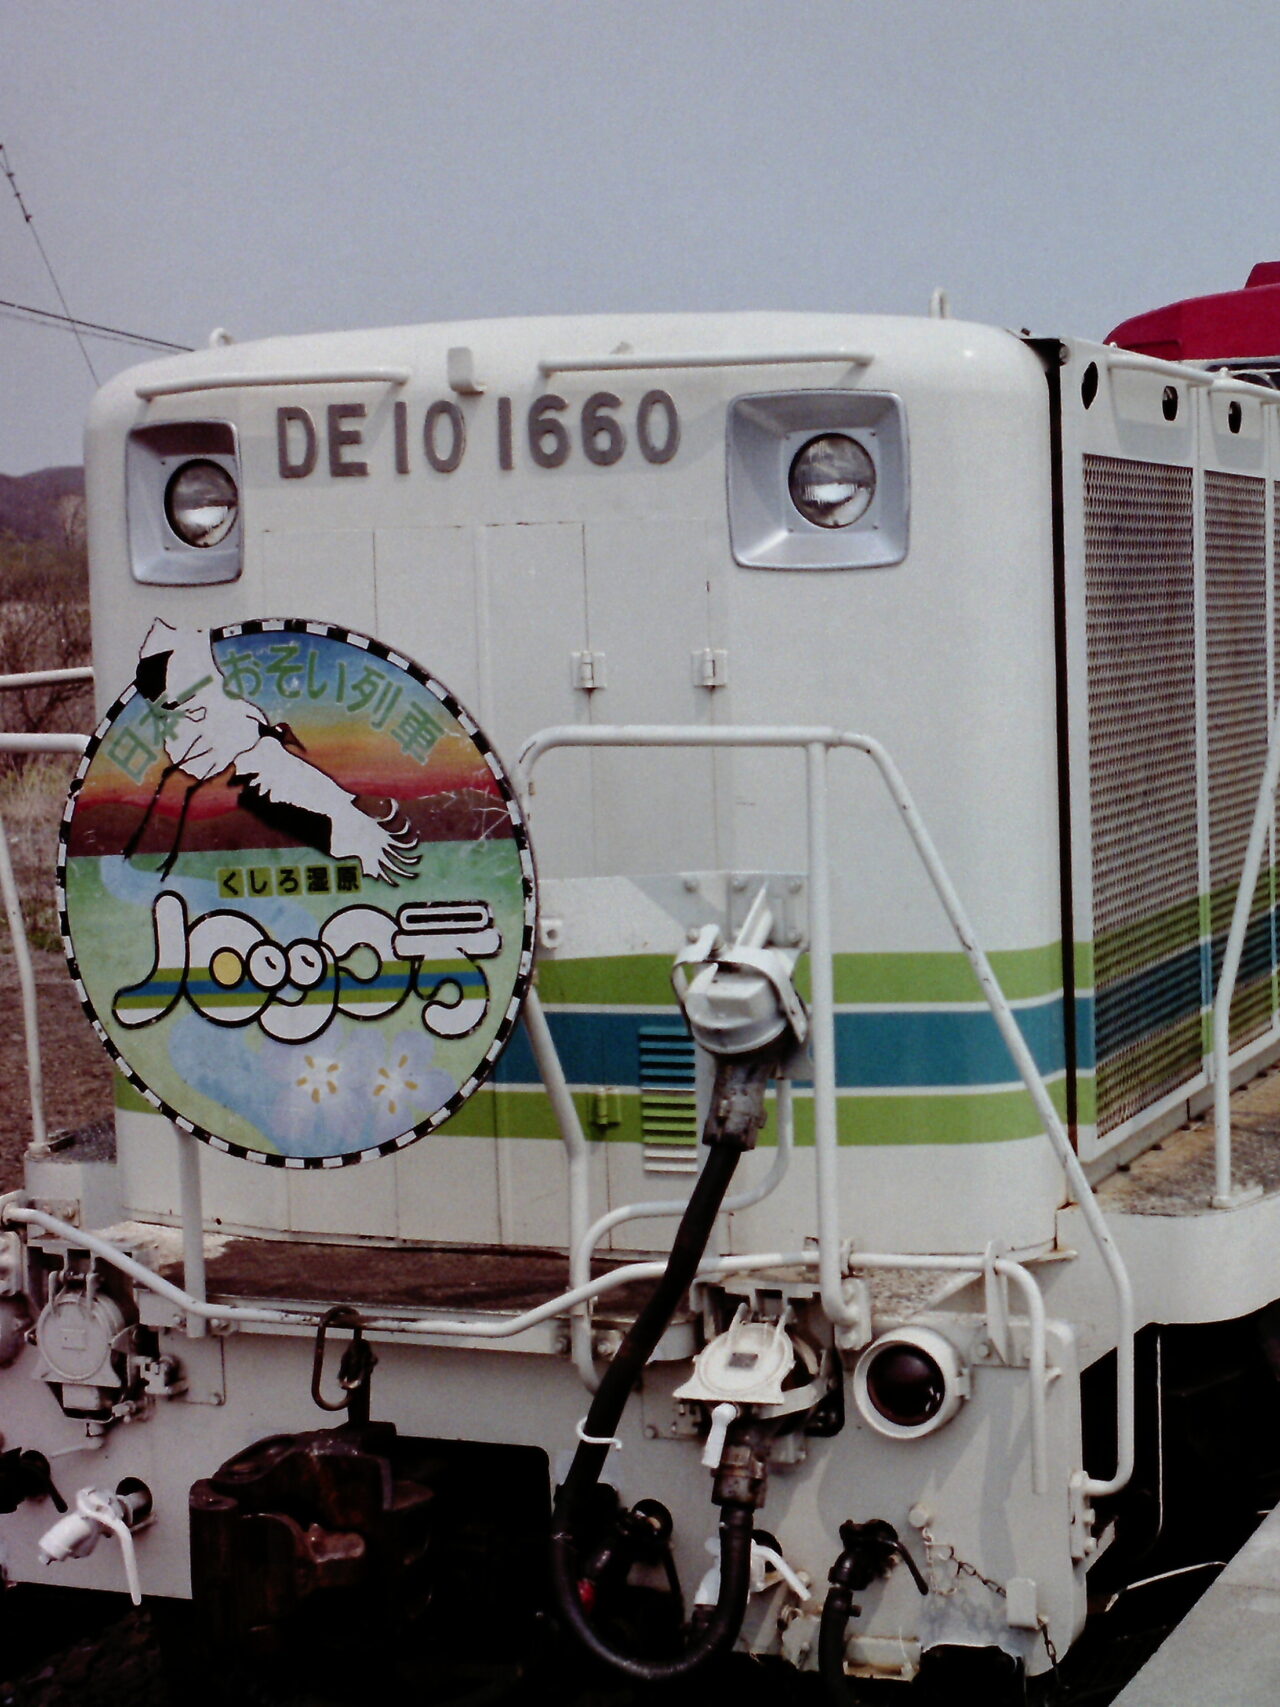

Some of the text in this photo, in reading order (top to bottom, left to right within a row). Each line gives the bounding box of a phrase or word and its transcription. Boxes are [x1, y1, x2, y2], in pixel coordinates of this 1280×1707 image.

[222, 865, 360, 896] くしろ湿原
